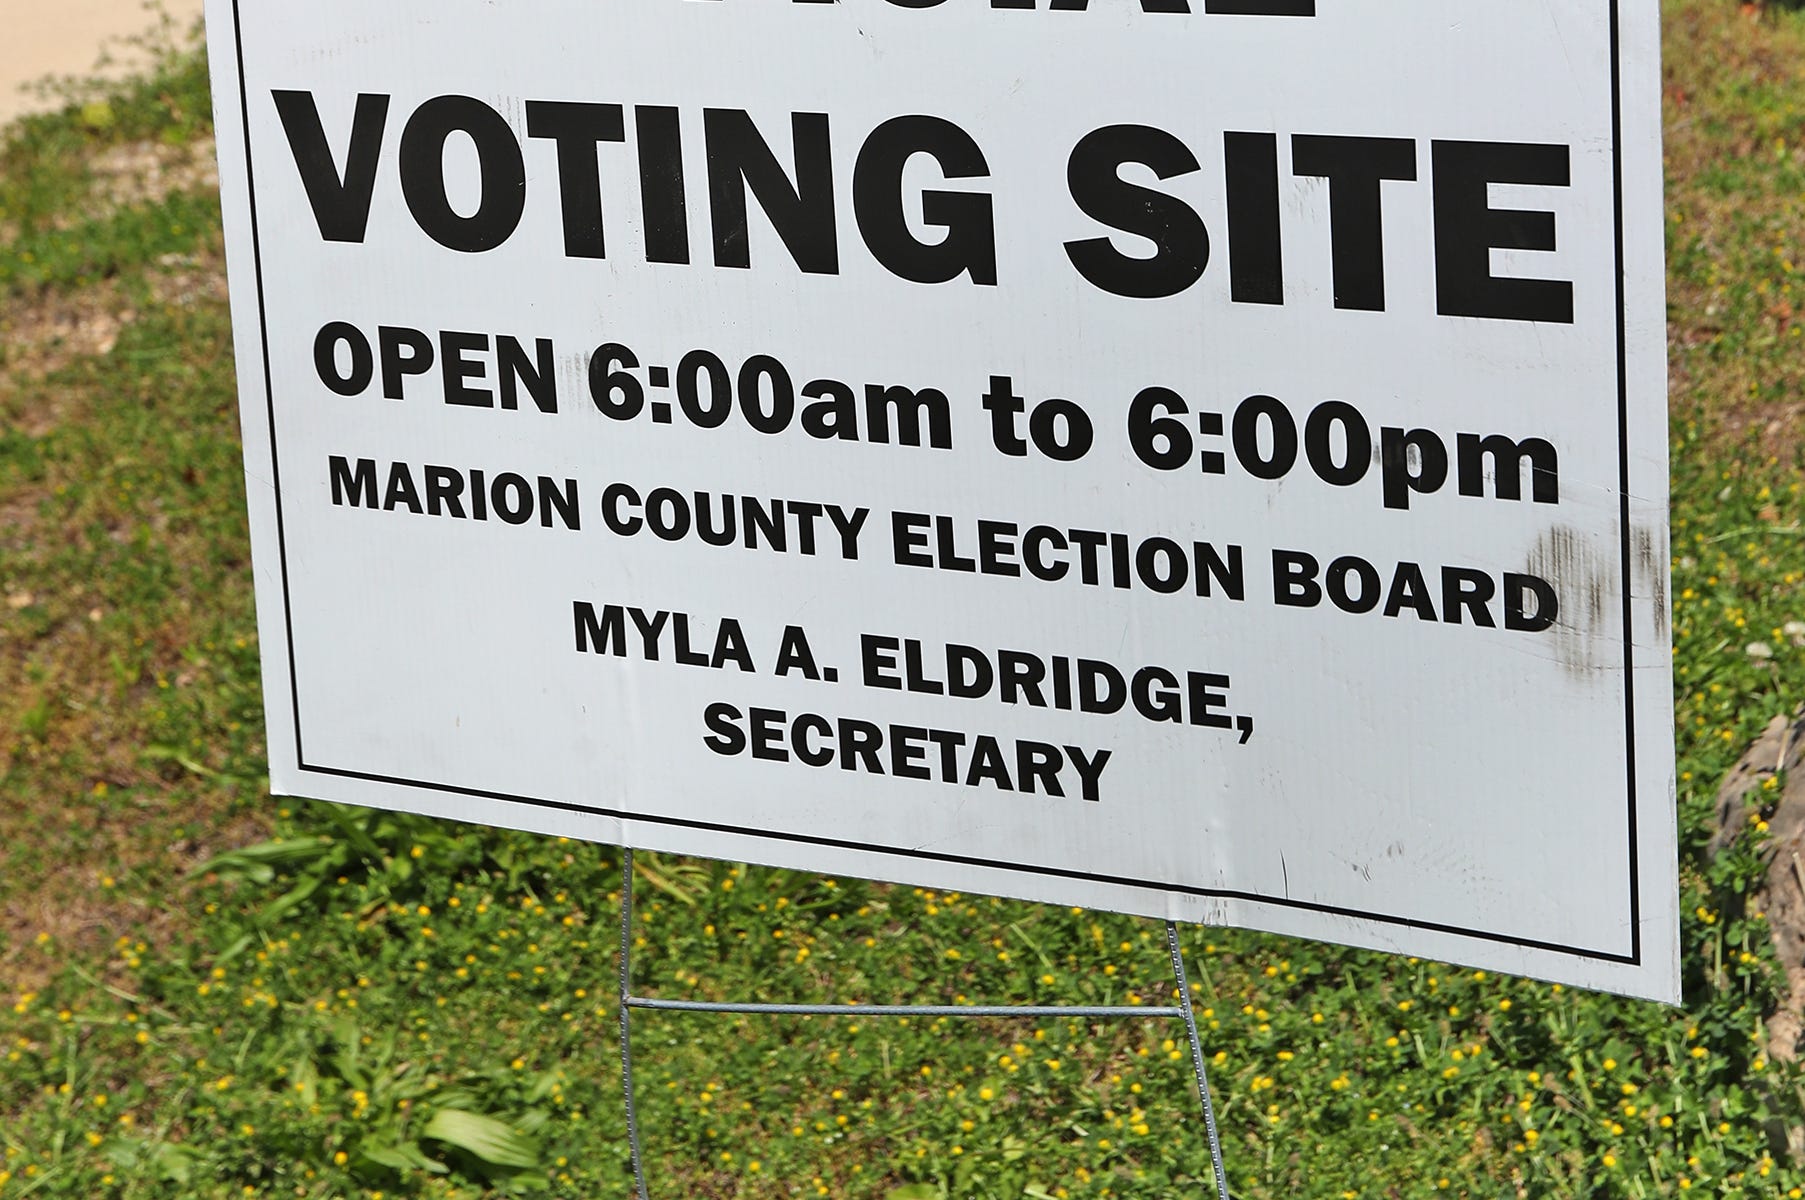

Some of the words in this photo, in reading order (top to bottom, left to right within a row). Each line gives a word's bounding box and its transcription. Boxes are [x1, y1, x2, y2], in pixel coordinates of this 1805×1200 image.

[270, 89, 998, 287] VOTING
[1062, 124, 1574, 325] SITE
[313, 321, 558, 414] OPEN
[588, 342, 953, 450] 6:00am
[981, 375, 1094, 462] to
[1127, 386, 1559, 511] 6:00pm
[328, 455, 581, 531] MARION
[601, 483, 870, 561] COUNTY
[891, 510, 1245, 602] ELECTION
[1271, 548, 1559, 633] BOARD
[573, 600, 756, 673] MYLA
[774, 625, 839, 683] A.
[860, 633, 1254, 745] ELDRIDGE,
[703, 702, 1113, 802] SECRETARY
